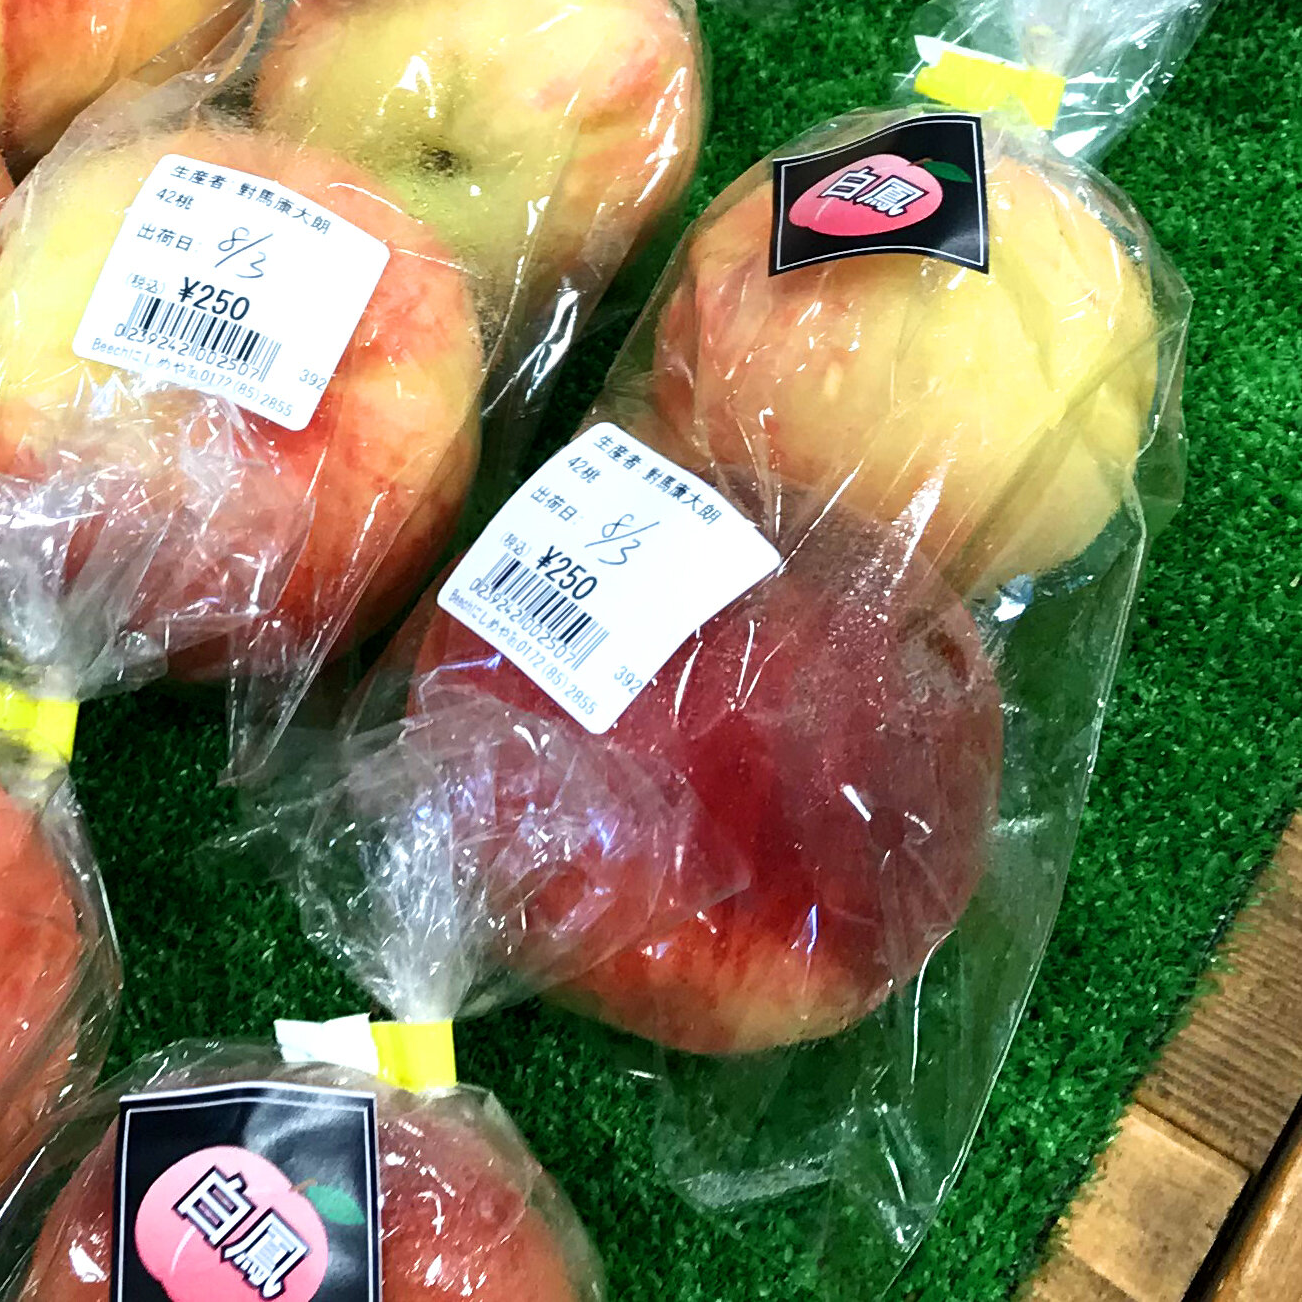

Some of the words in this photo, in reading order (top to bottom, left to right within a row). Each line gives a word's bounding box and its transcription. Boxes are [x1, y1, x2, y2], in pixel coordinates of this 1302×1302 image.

[155, 187, 195, 211] 42桃
[820, 166, 925, 216] 白鳳
[214, 226, 274, 279] 8/3
[178, 276, 251, 322] ¥250
[299, 368, 327, 391] 392
[567, 456, 602, 485] 42桃
[584, 513, 660, 566] 8/3
[536, 545, 598, 601] ¥250
[613, 665, 644, 696] 392
[173, 1164, 313, 1300] 白鳳
